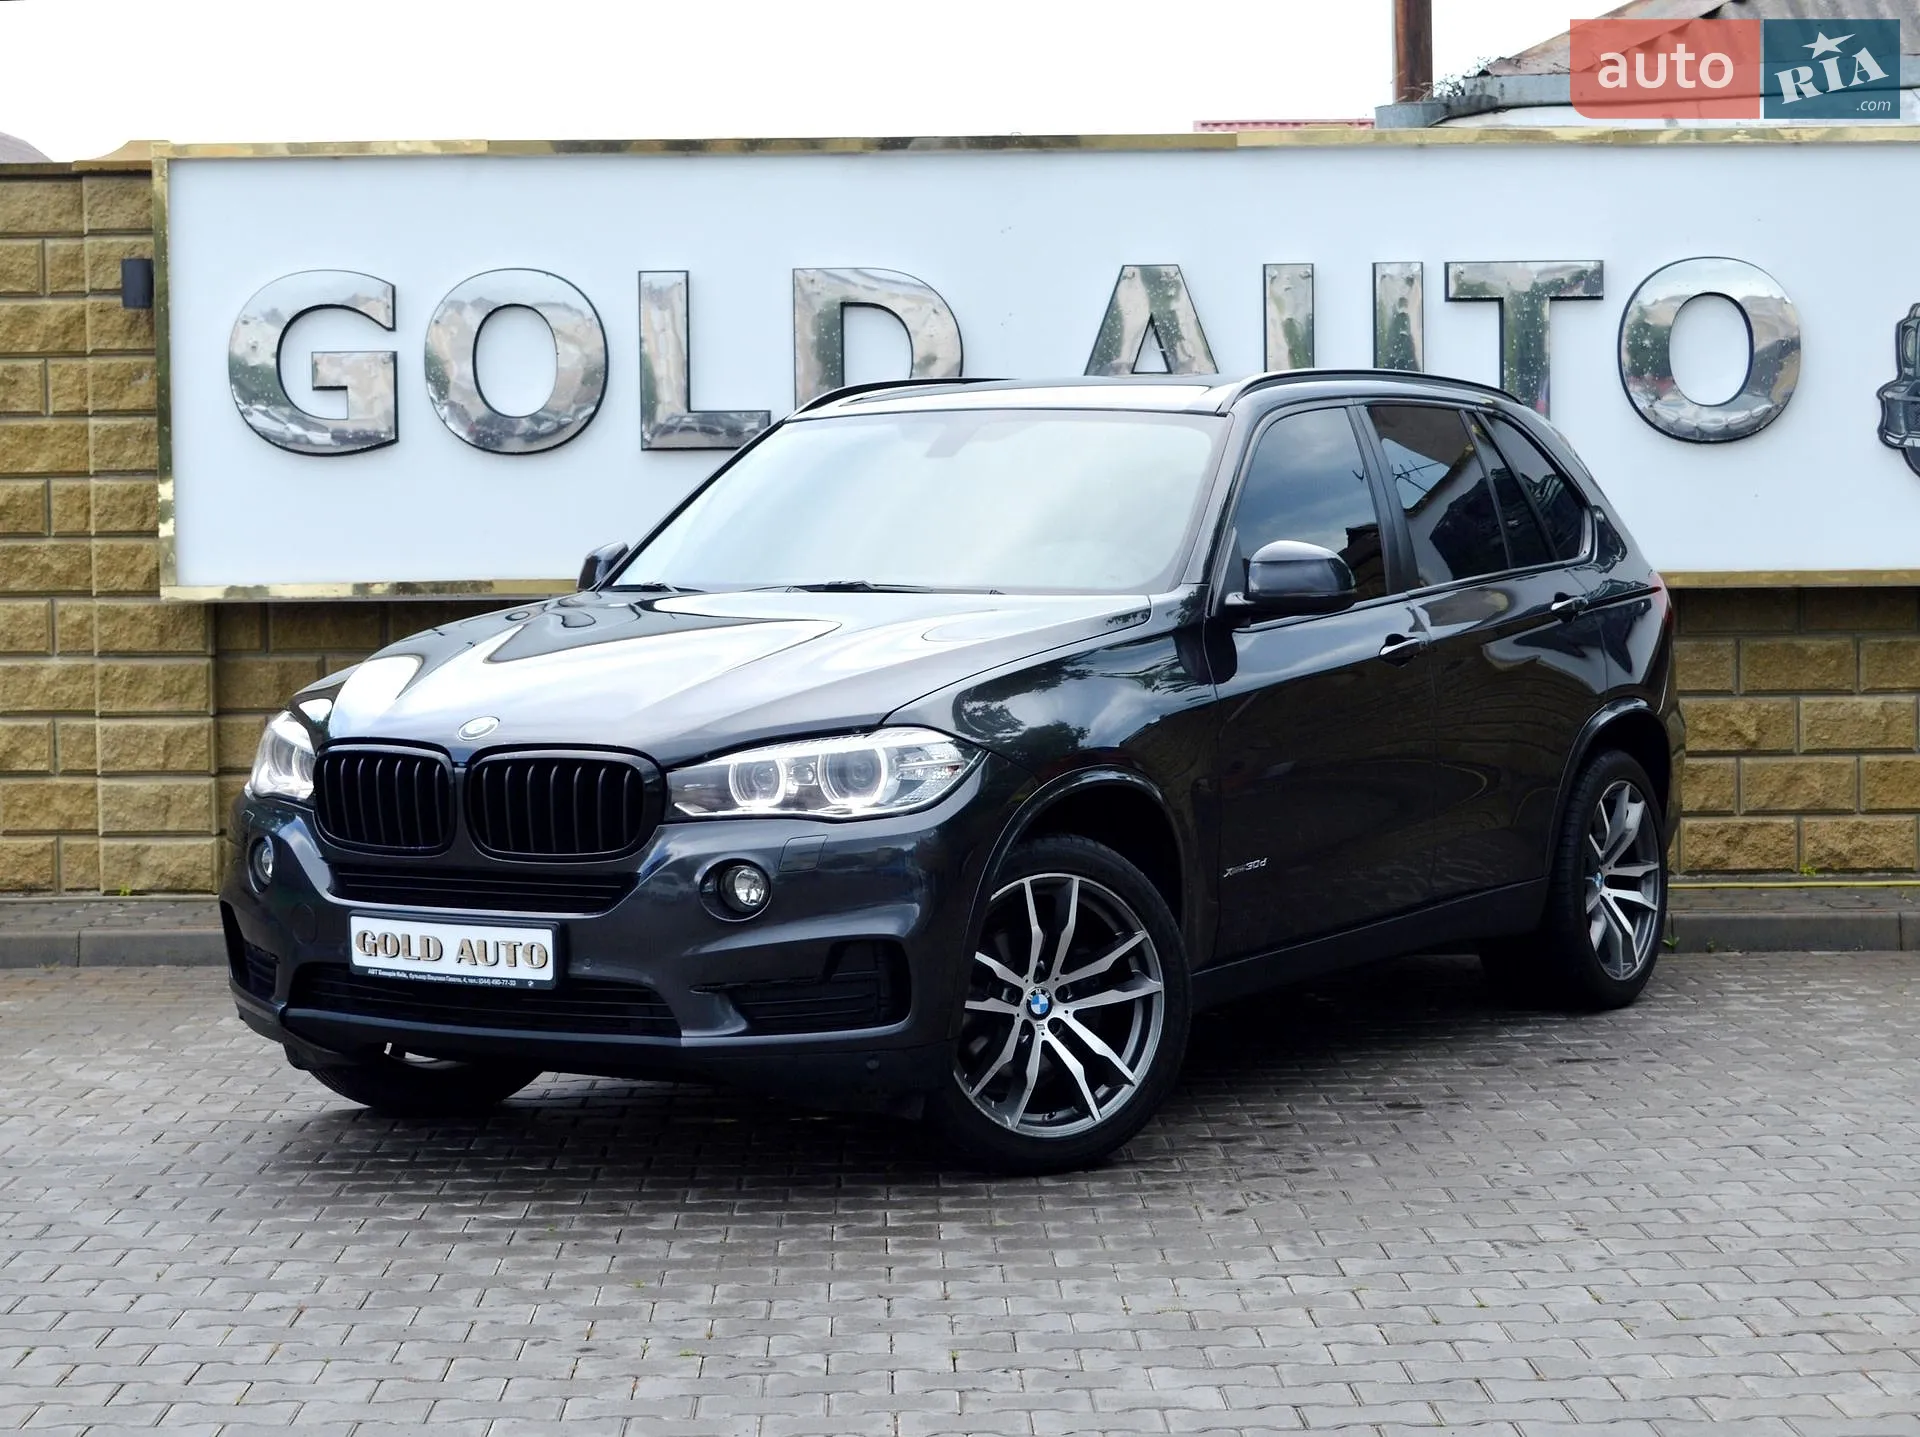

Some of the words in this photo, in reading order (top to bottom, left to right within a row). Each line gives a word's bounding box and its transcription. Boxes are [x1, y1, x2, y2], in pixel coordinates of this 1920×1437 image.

[228, 267, 964, 457] GOLD
[355, 929, 444, 962] GOLD
[455, 938, 549, 969] AUTO
